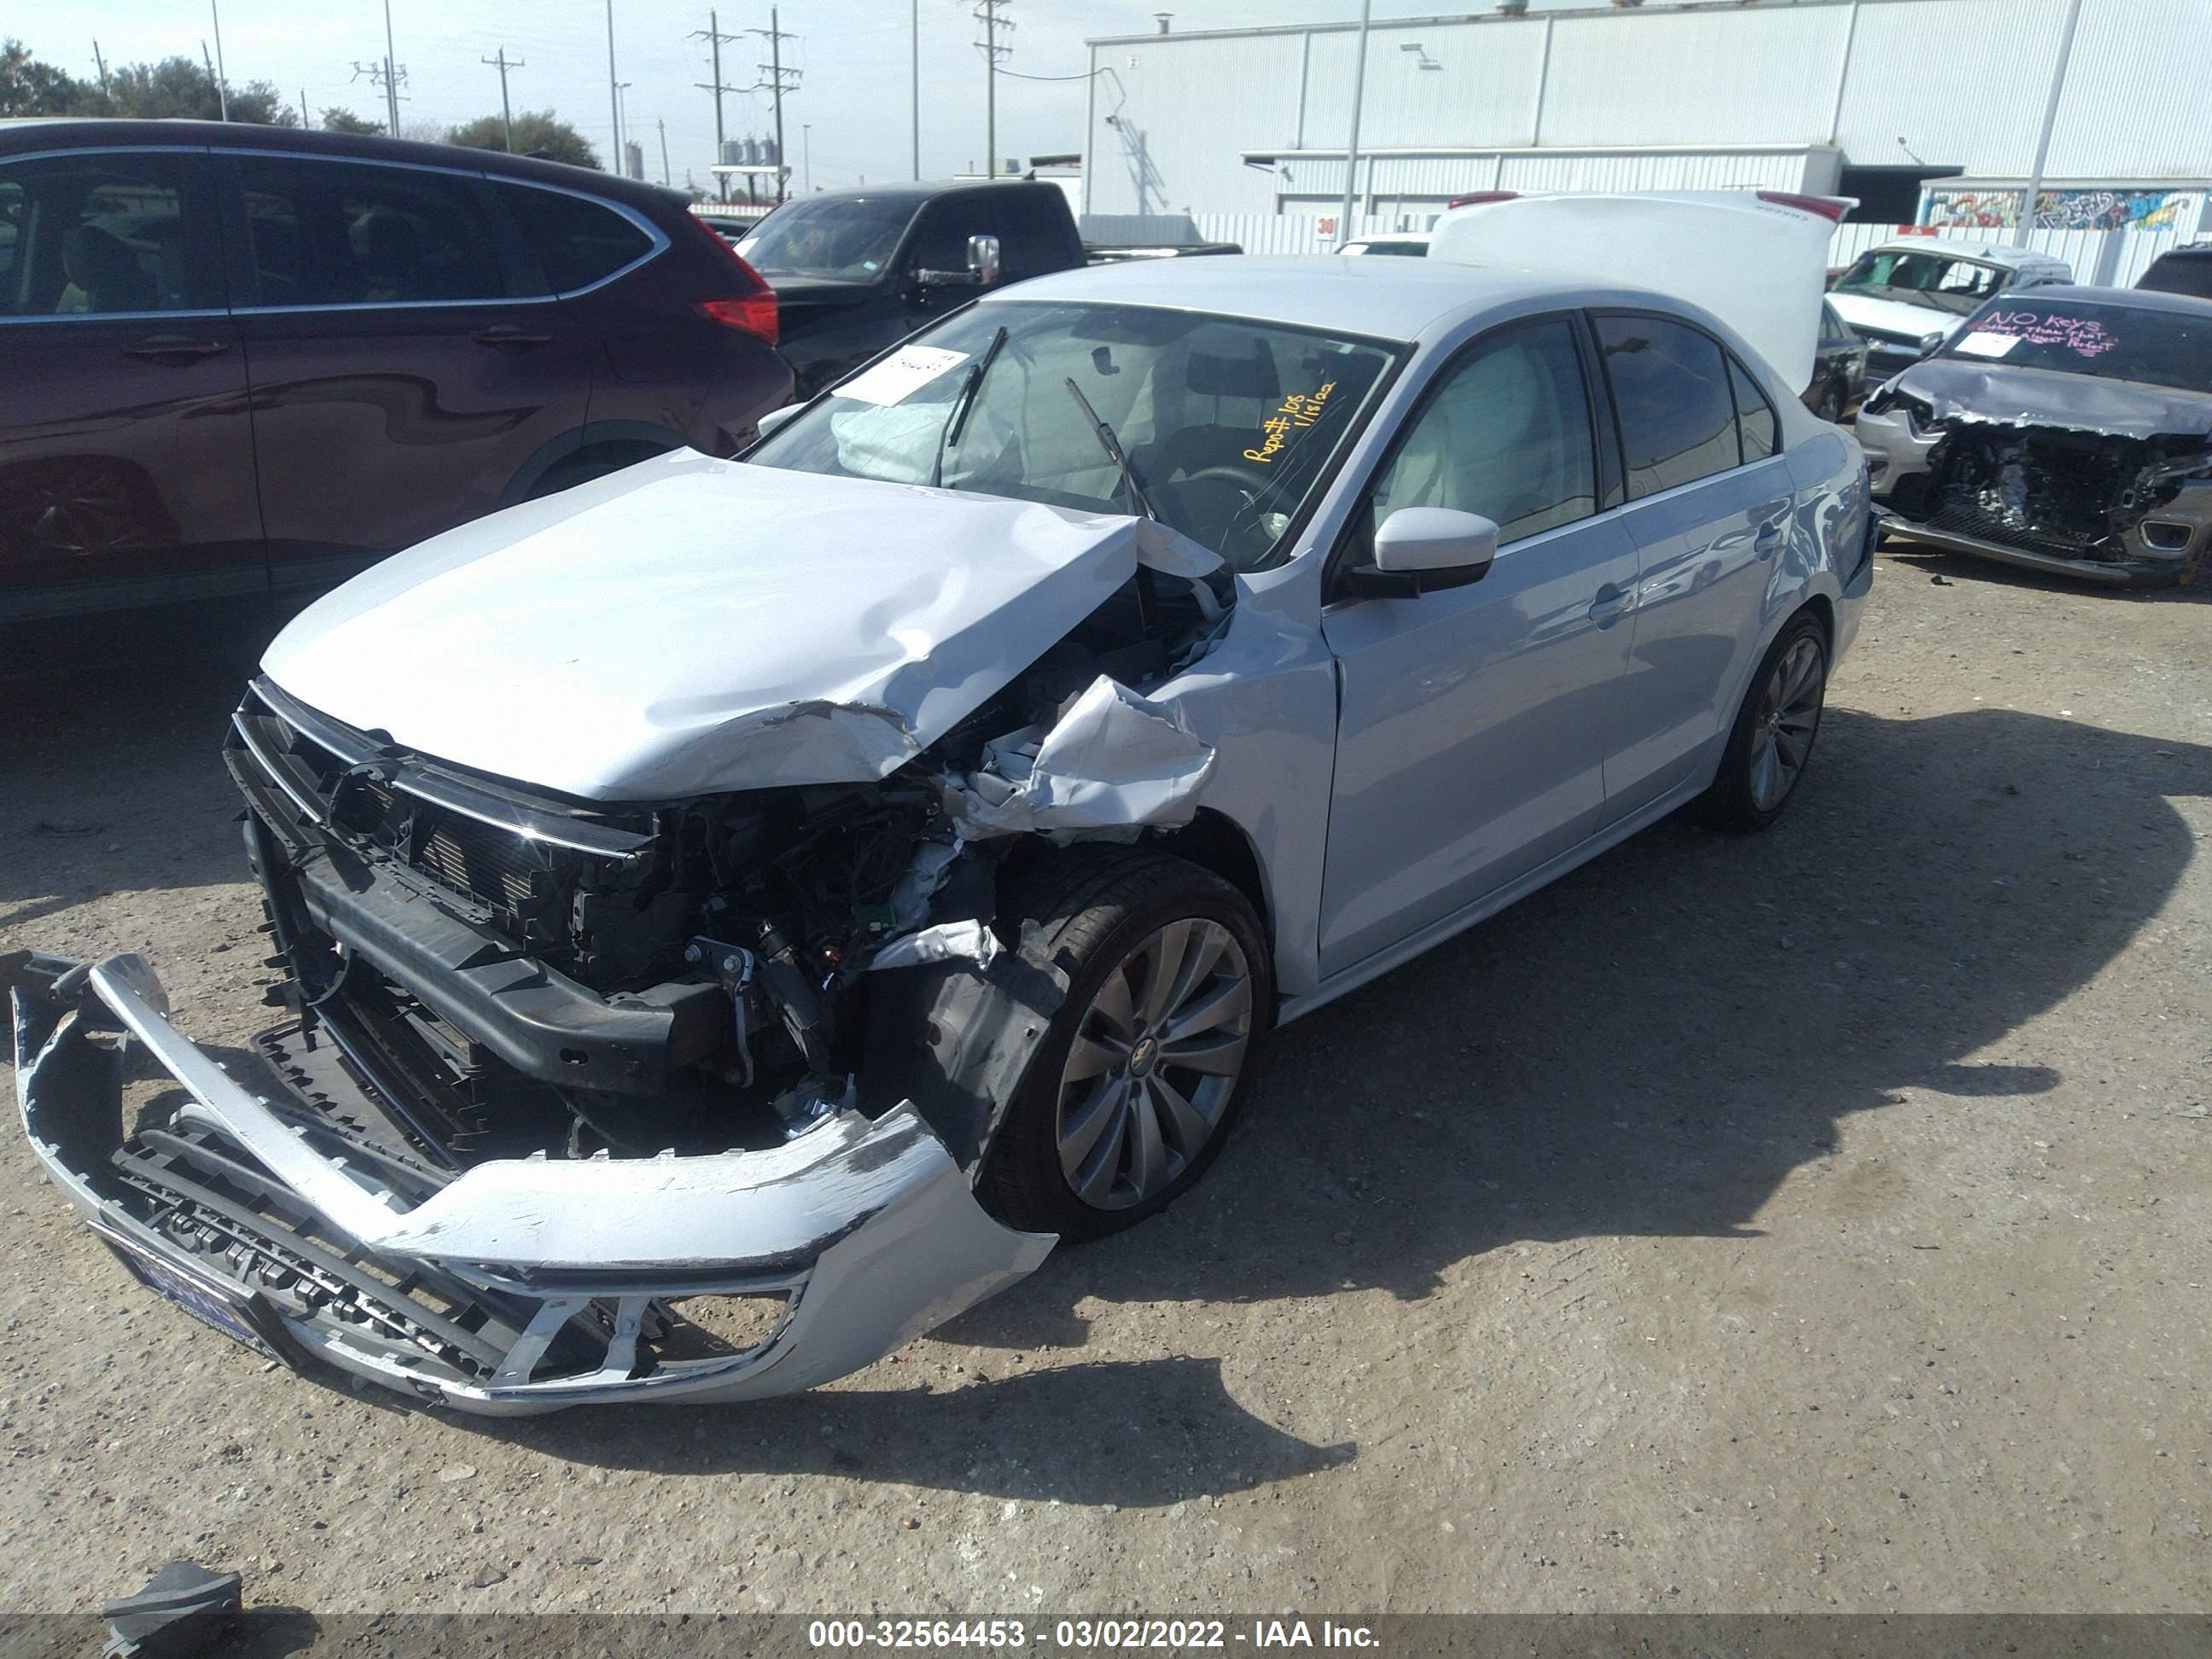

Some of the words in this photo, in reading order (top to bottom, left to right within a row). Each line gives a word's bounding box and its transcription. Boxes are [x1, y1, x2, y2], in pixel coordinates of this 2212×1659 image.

[1318, 218, 1334, 234] 30
[1984, 311, 2038, 325] NO
[1294, 381, 1337, 427] 1/18/22
